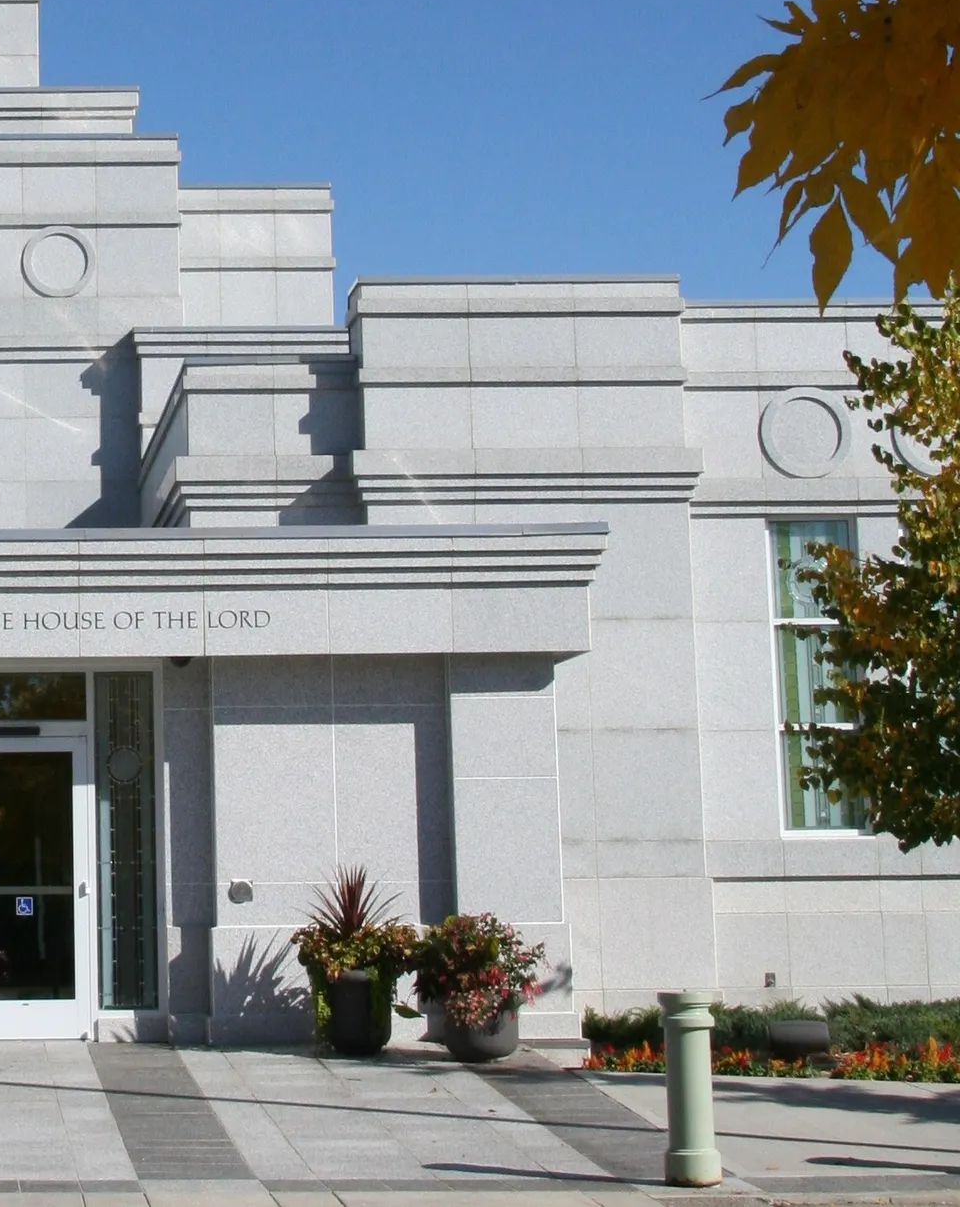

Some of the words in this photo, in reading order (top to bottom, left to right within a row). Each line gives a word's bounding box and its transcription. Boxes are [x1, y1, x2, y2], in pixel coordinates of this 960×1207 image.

[23, 611, 106, 630] HOUSE
[113, 611, 145, 630] OF
[152, 610, 198, 629] THE
[207, 610, 271, 629] LORD
